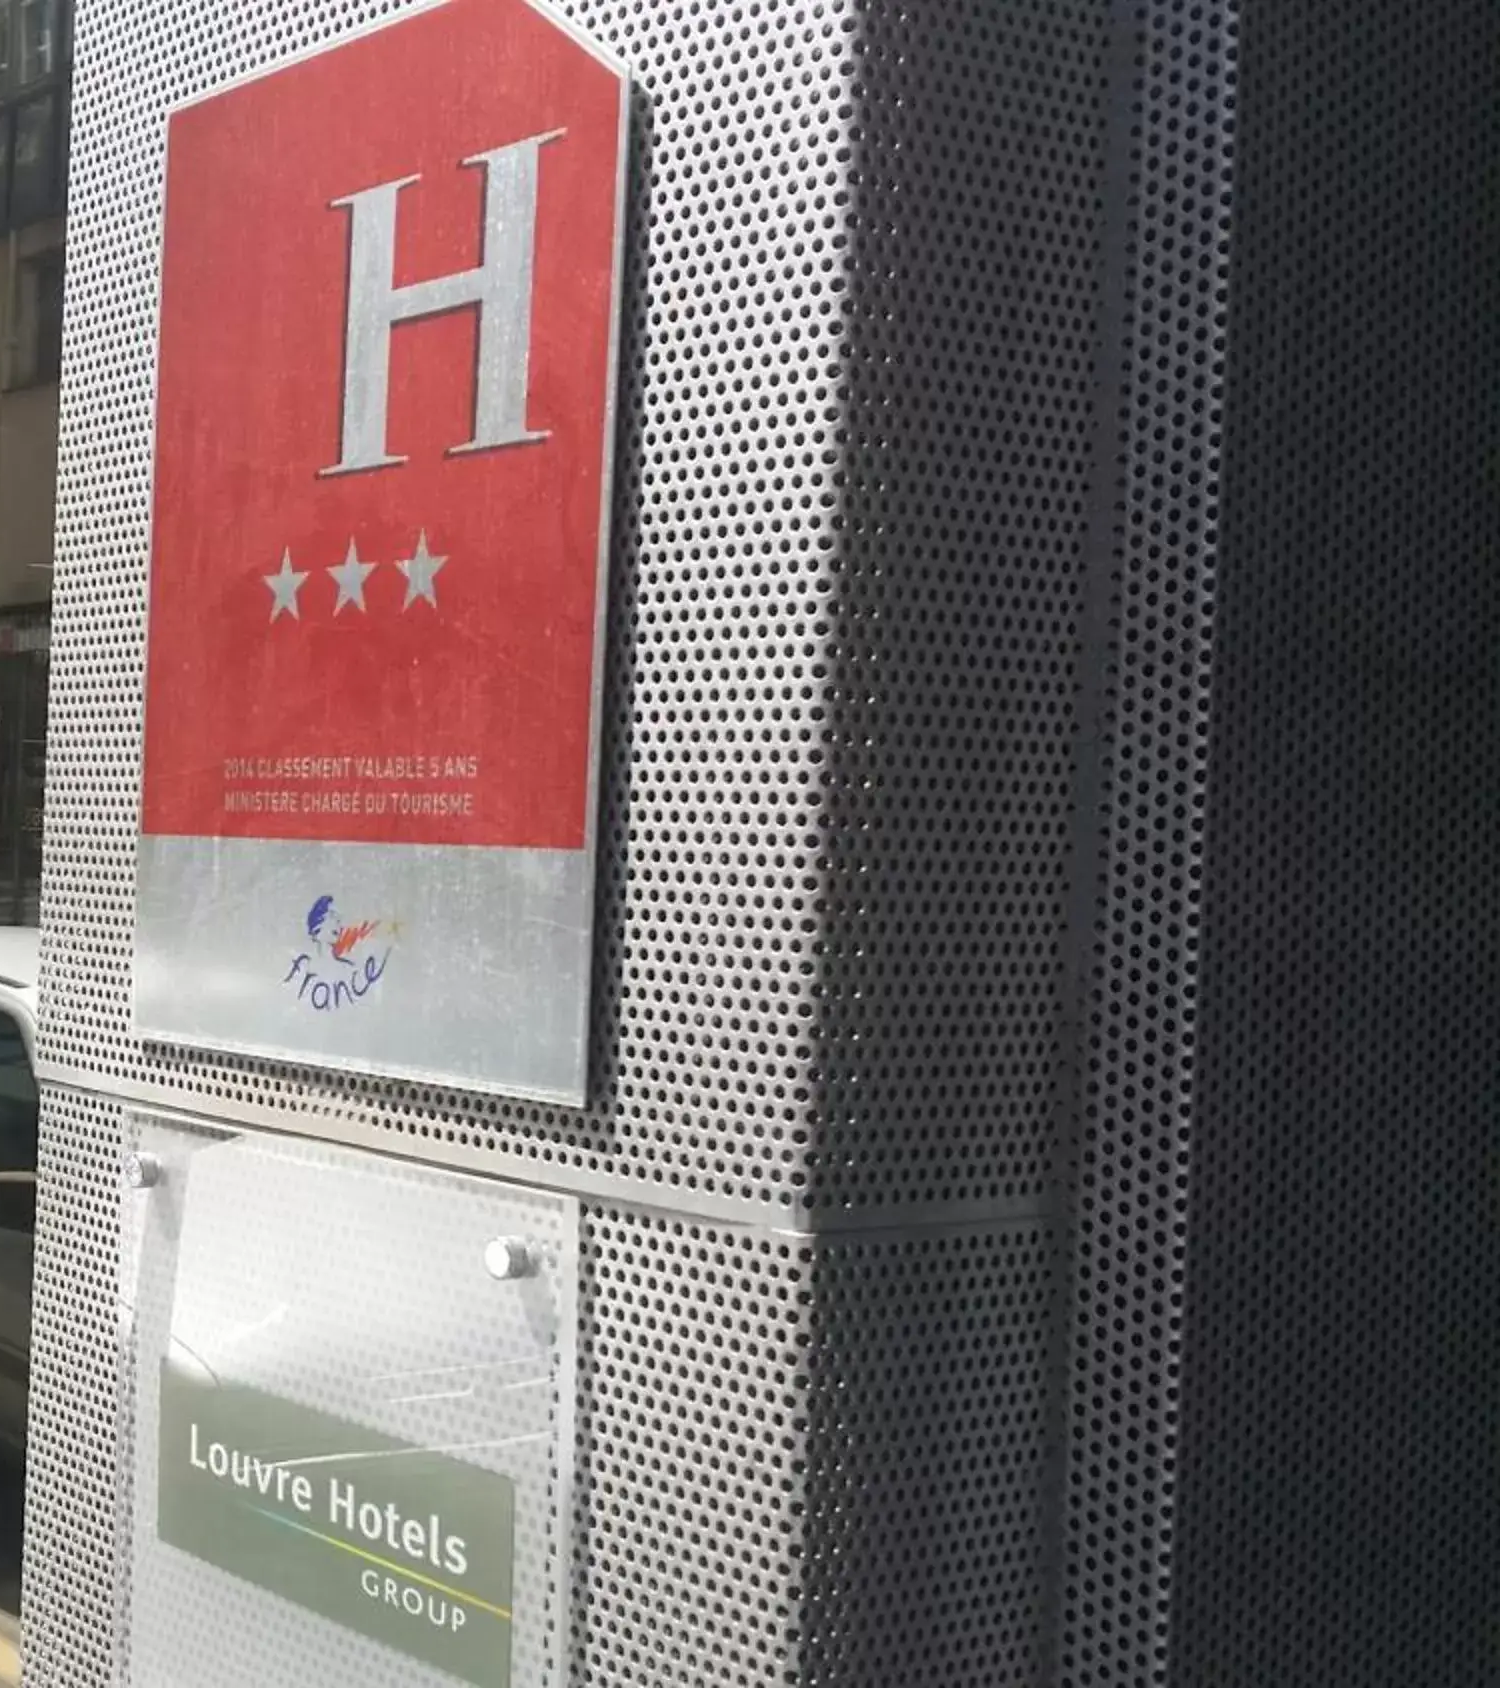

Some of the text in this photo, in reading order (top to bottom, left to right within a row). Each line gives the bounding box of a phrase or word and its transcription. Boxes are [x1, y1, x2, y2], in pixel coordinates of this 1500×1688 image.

[317, 127, 568, 478] H
[257, 757, 350, 780] CLASSEMENT
[355, 756, 425, 780] VALABLE
[429, 757, 440, 779] 5
[444, 756, 478, 779] ANS
[365, 792, 387, 814] DU
[391, 791, 474, 816] TOURISME
[190, 1423, 468, 1575] Louvre Hotels
[360, 1568, 467, 1632] GROUP
